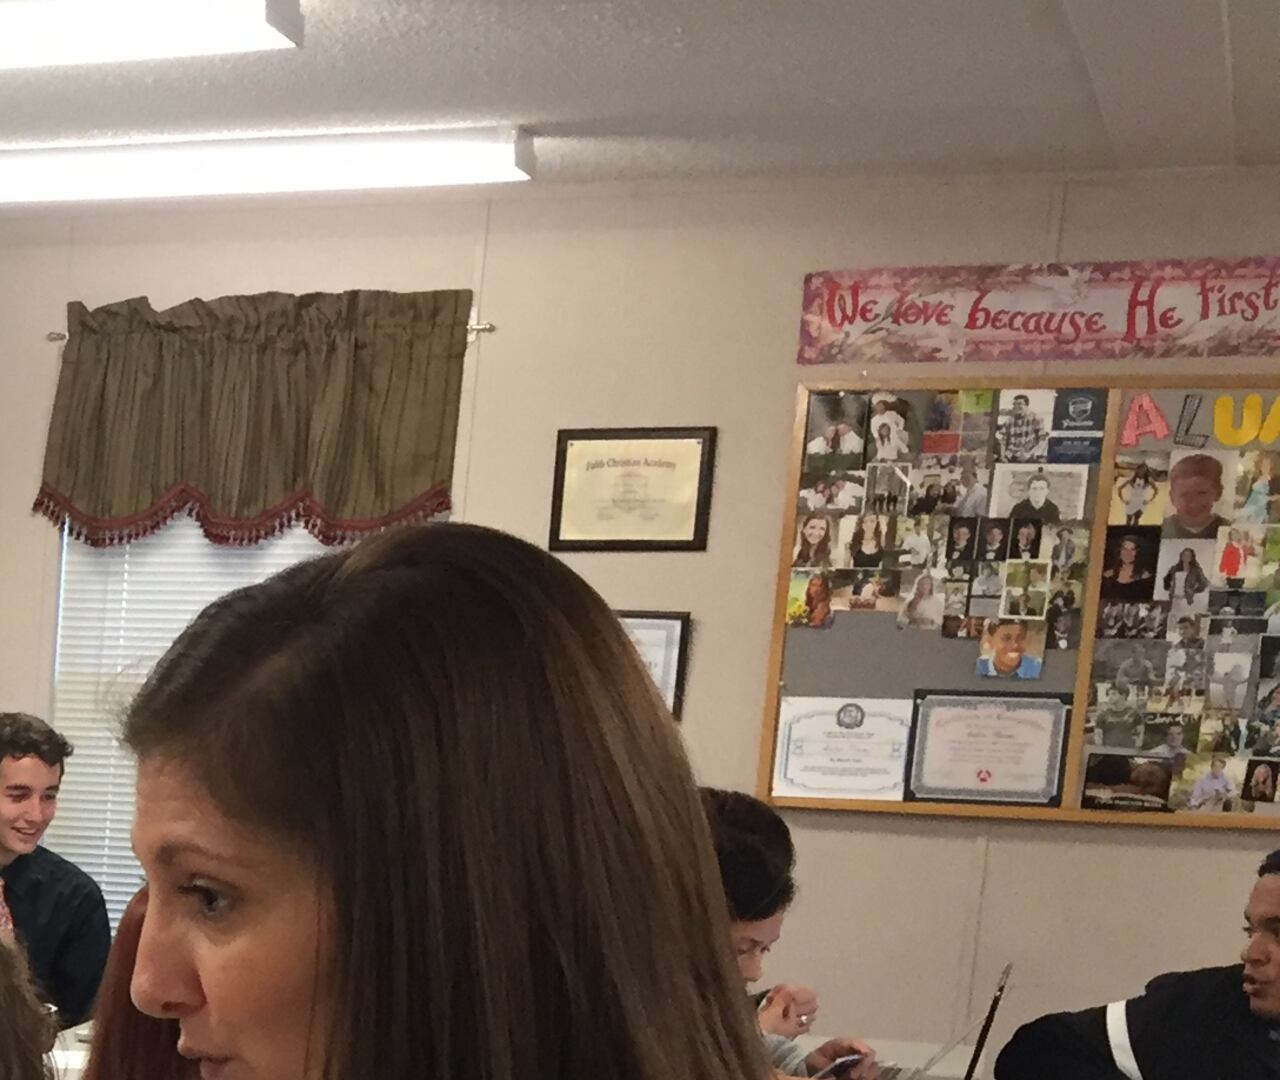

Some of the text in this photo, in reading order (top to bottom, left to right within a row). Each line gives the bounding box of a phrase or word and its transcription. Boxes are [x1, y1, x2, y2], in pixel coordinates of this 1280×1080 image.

[825, 279, 880, 331] We
[890, 289, 955, 326] love
[964, 286, 1107, 344] because
[1120, 274, 1184, 344] He
